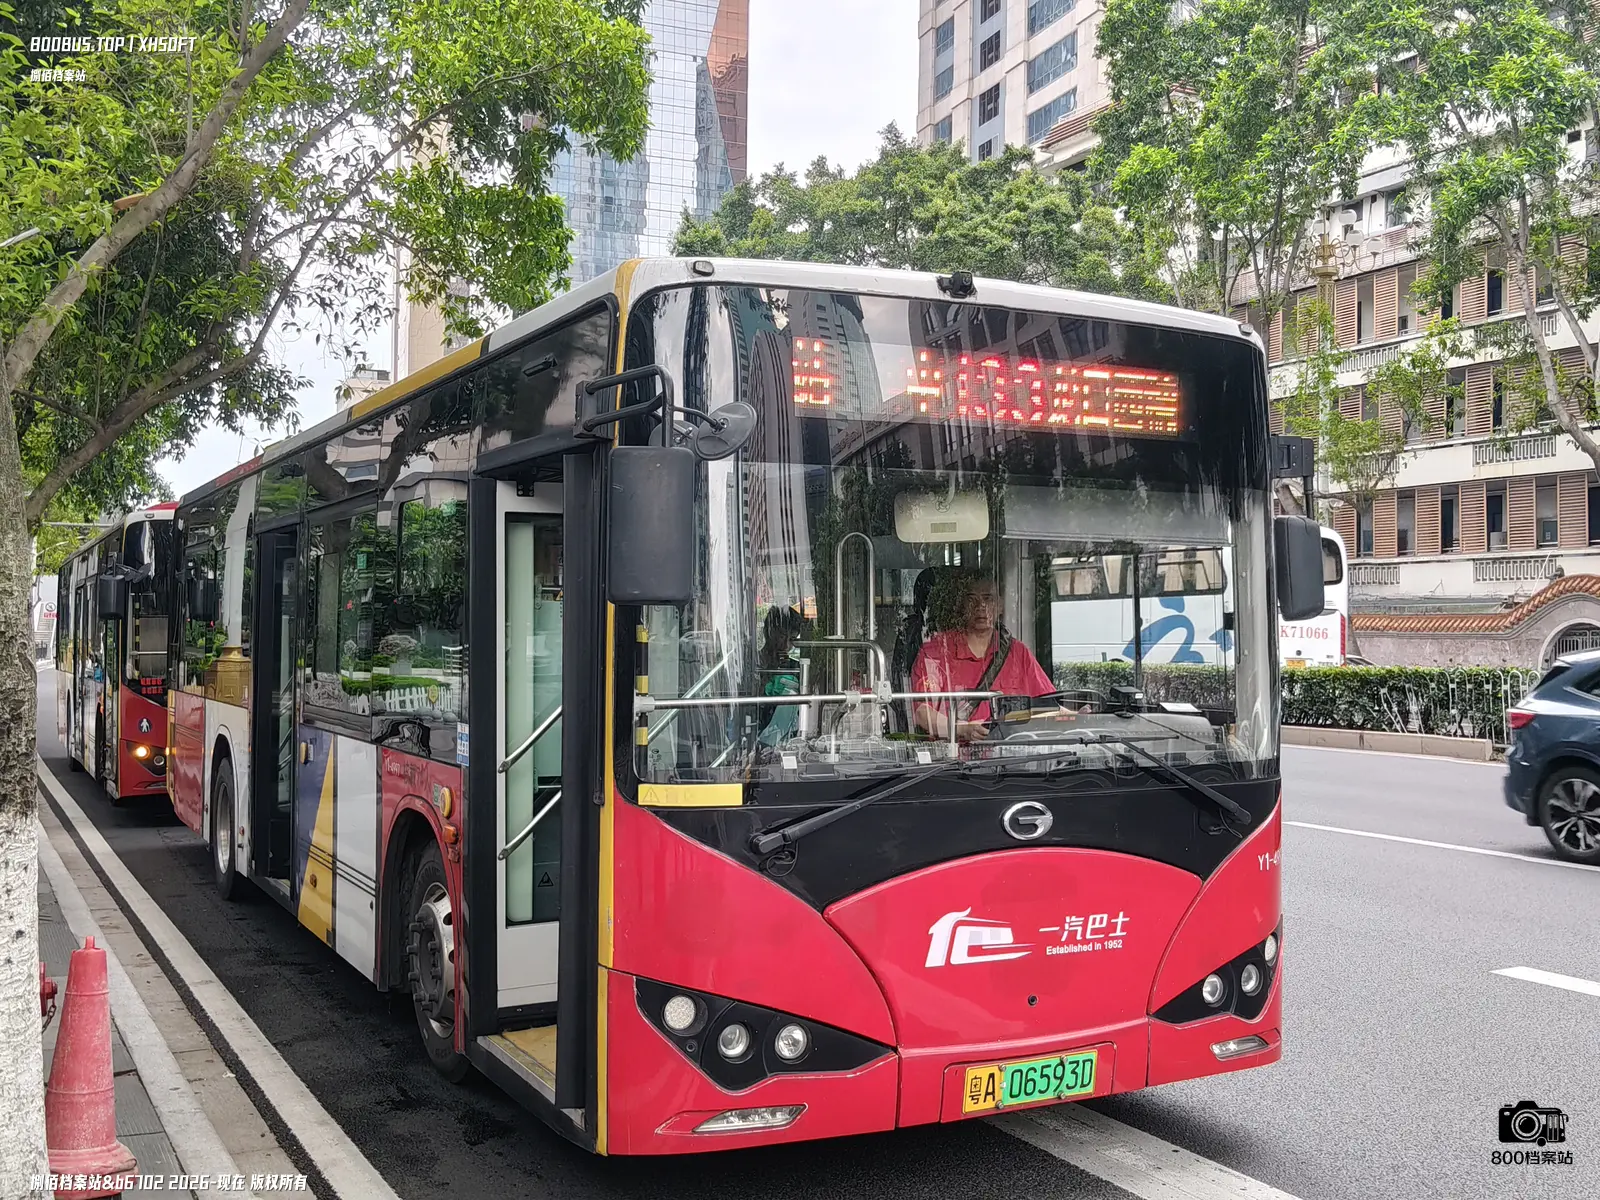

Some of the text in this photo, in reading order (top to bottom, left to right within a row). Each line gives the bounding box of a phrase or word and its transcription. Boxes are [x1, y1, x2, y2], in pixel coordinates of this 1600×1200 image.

[1280, 625, 1329, 640] K71066
[1039, 911, 1130, 942] 一汽巴士
[1046, 939, 1123, 955] Established in 1952
